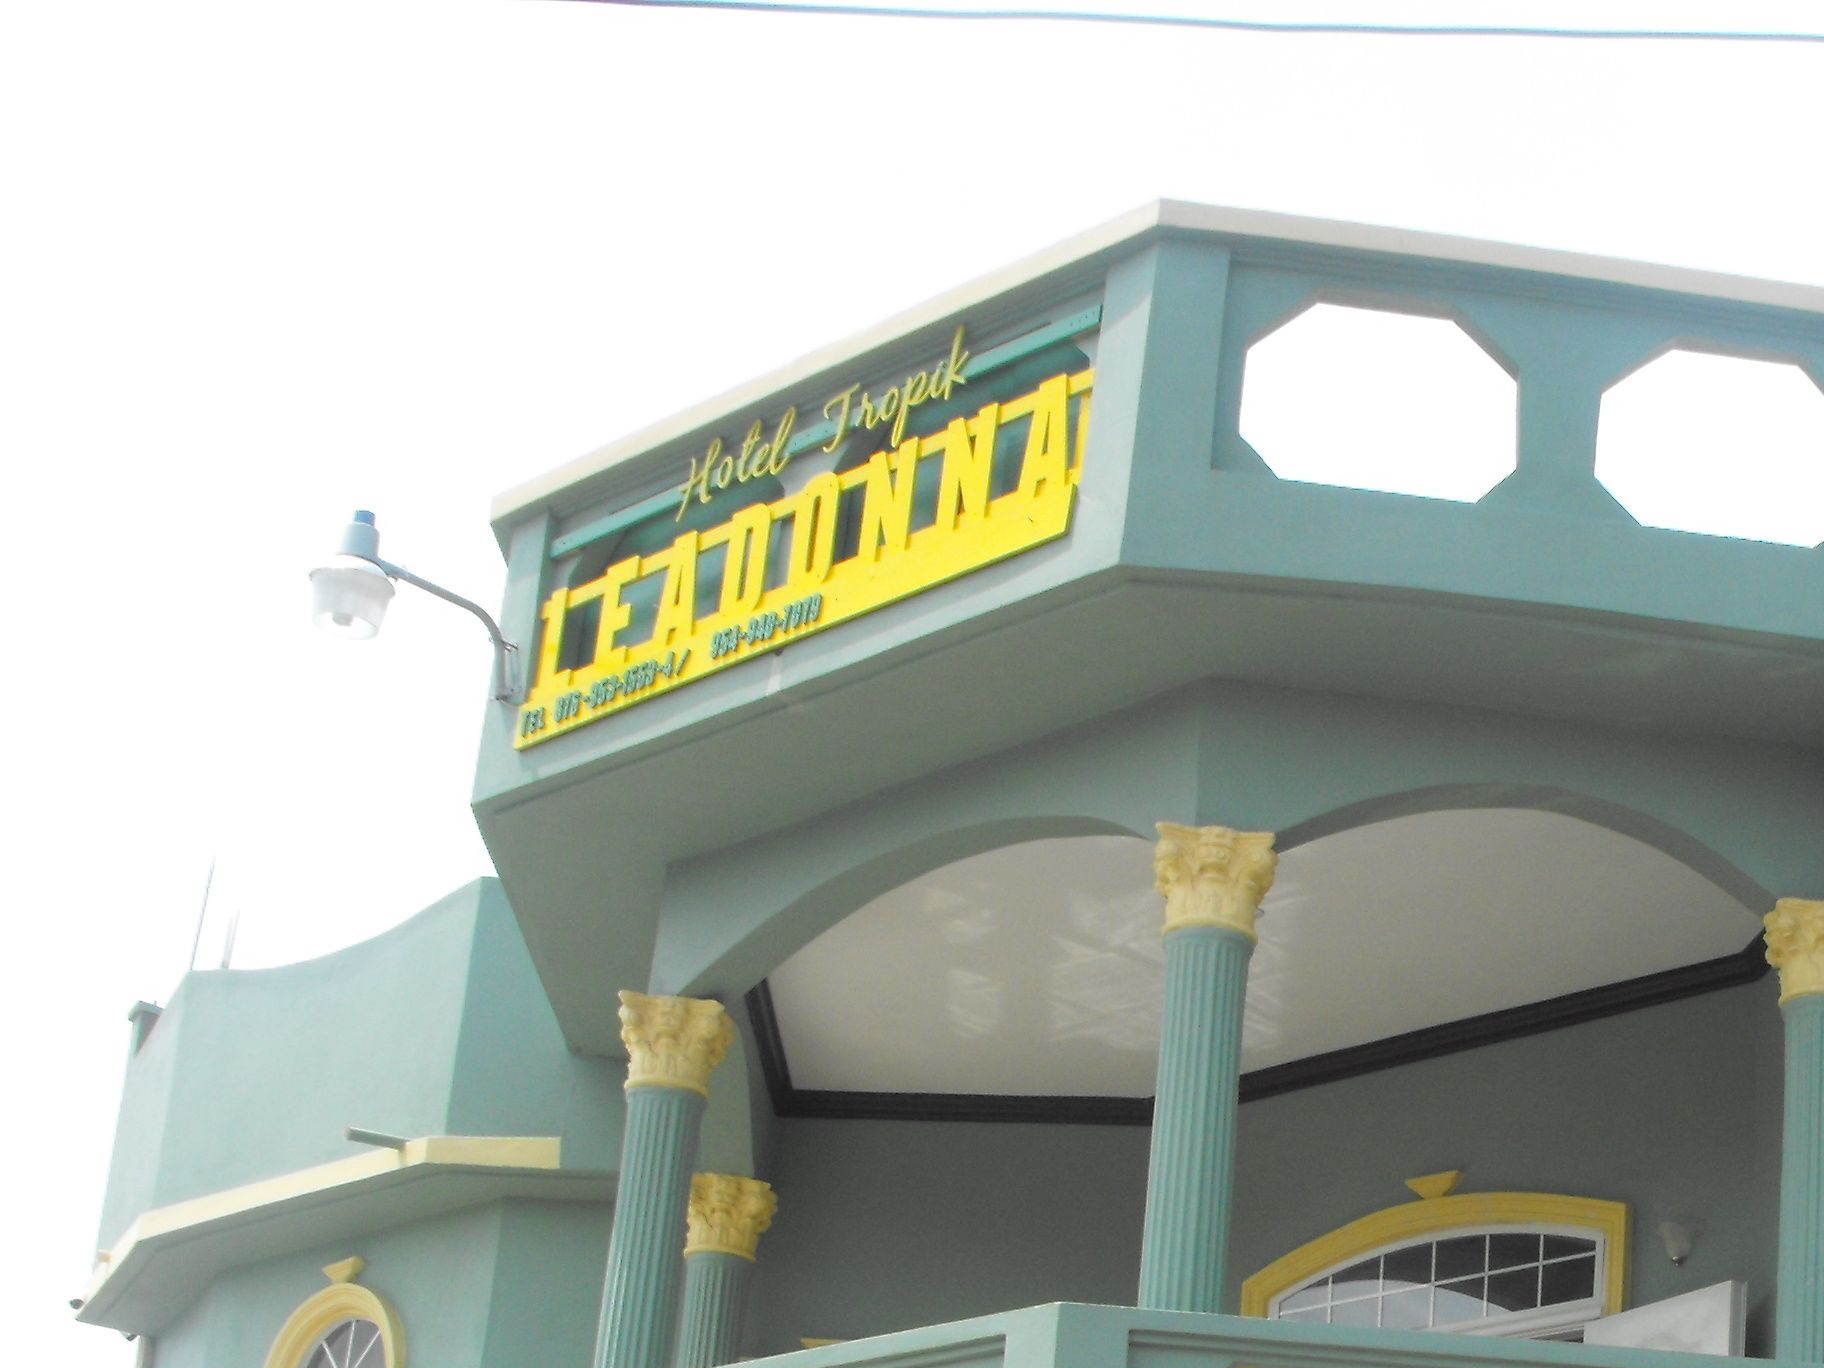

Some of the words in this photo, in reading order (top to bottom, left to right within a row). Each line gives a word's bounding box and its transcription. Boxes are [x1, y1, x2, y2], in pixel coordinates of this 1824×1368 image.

[676, 405, 798, 523] Hotel
[822, 324, 969, 453] Tropik
[530, 373, 1069, 690] LEADONNA
[522, 706, 546, 738] TEL
